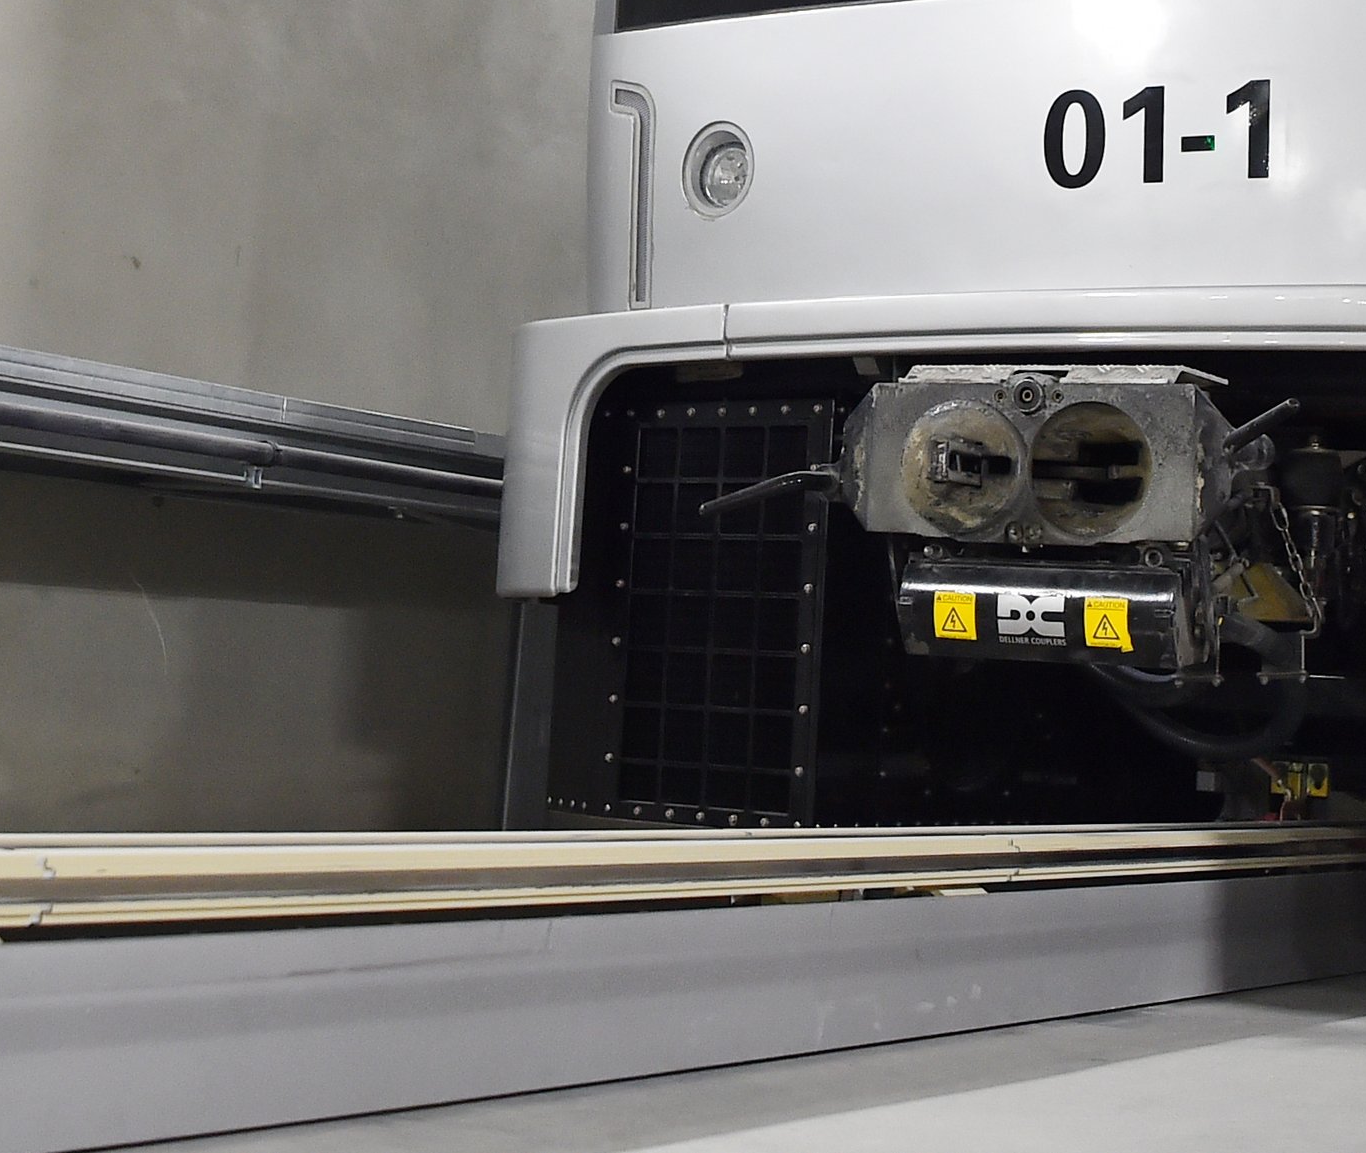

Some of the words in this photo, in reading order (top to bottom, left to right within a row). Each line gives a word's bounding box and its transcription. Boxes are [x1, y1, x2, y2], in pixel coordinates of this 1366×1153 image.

[1044, 79, 1271, 189] 01-1
[943, 594, 972, 602] CAUTION
[999, 636, 1030, 644] DELLNER
[1031, 637, 1067, 646] COUPLERS
